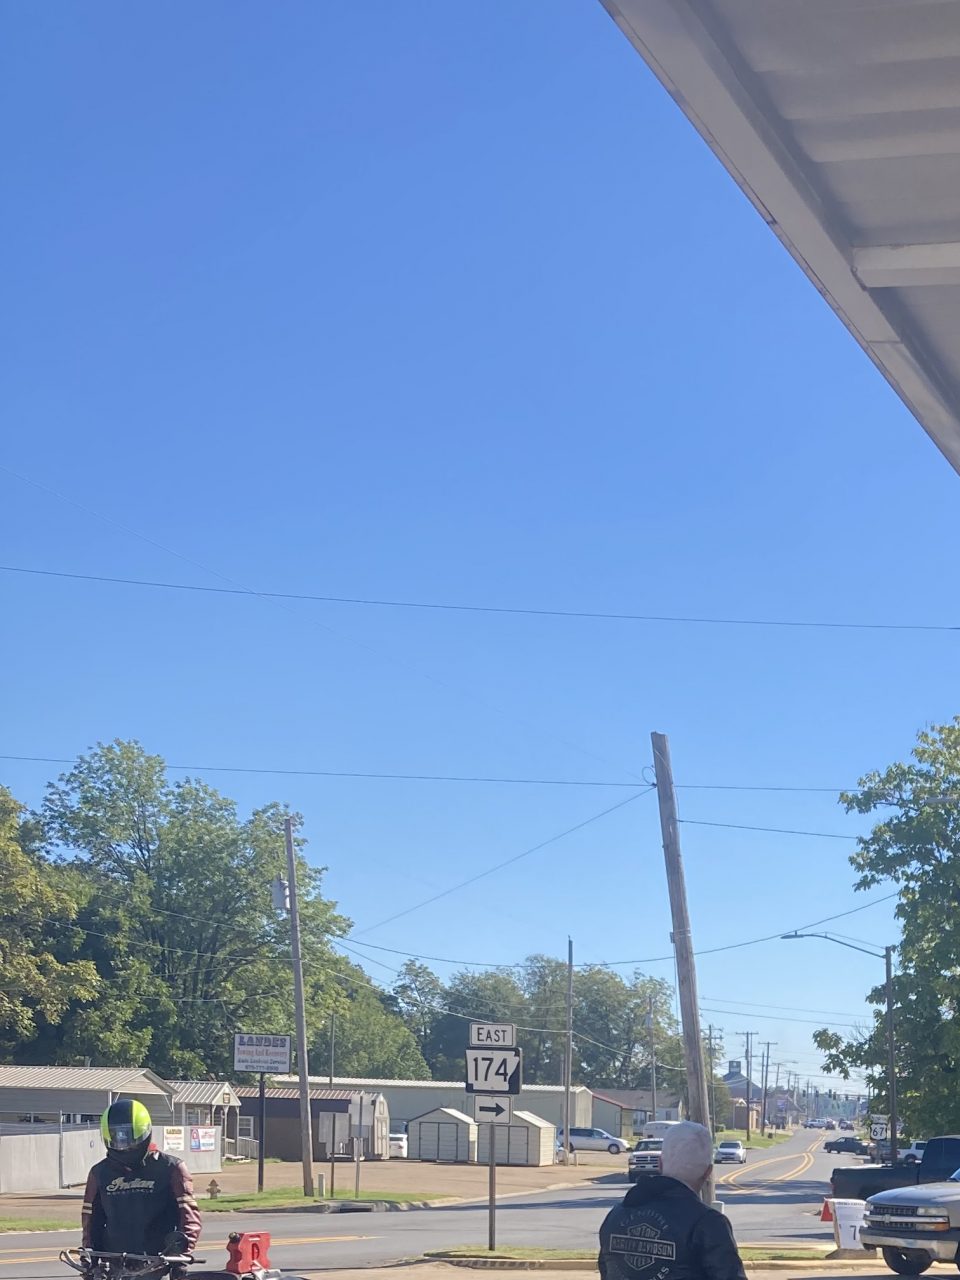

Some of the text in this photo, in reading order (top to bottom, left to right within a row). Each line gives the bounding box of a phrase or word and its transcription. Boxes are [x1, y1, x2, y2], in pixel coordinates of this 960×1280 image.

[477, 1027, 507, 1042] EAST
[473, 1057, 508, 1082] 174
[873, 1127, 885, 1137] 67
[106, 1176, 155, 1191] Indian
